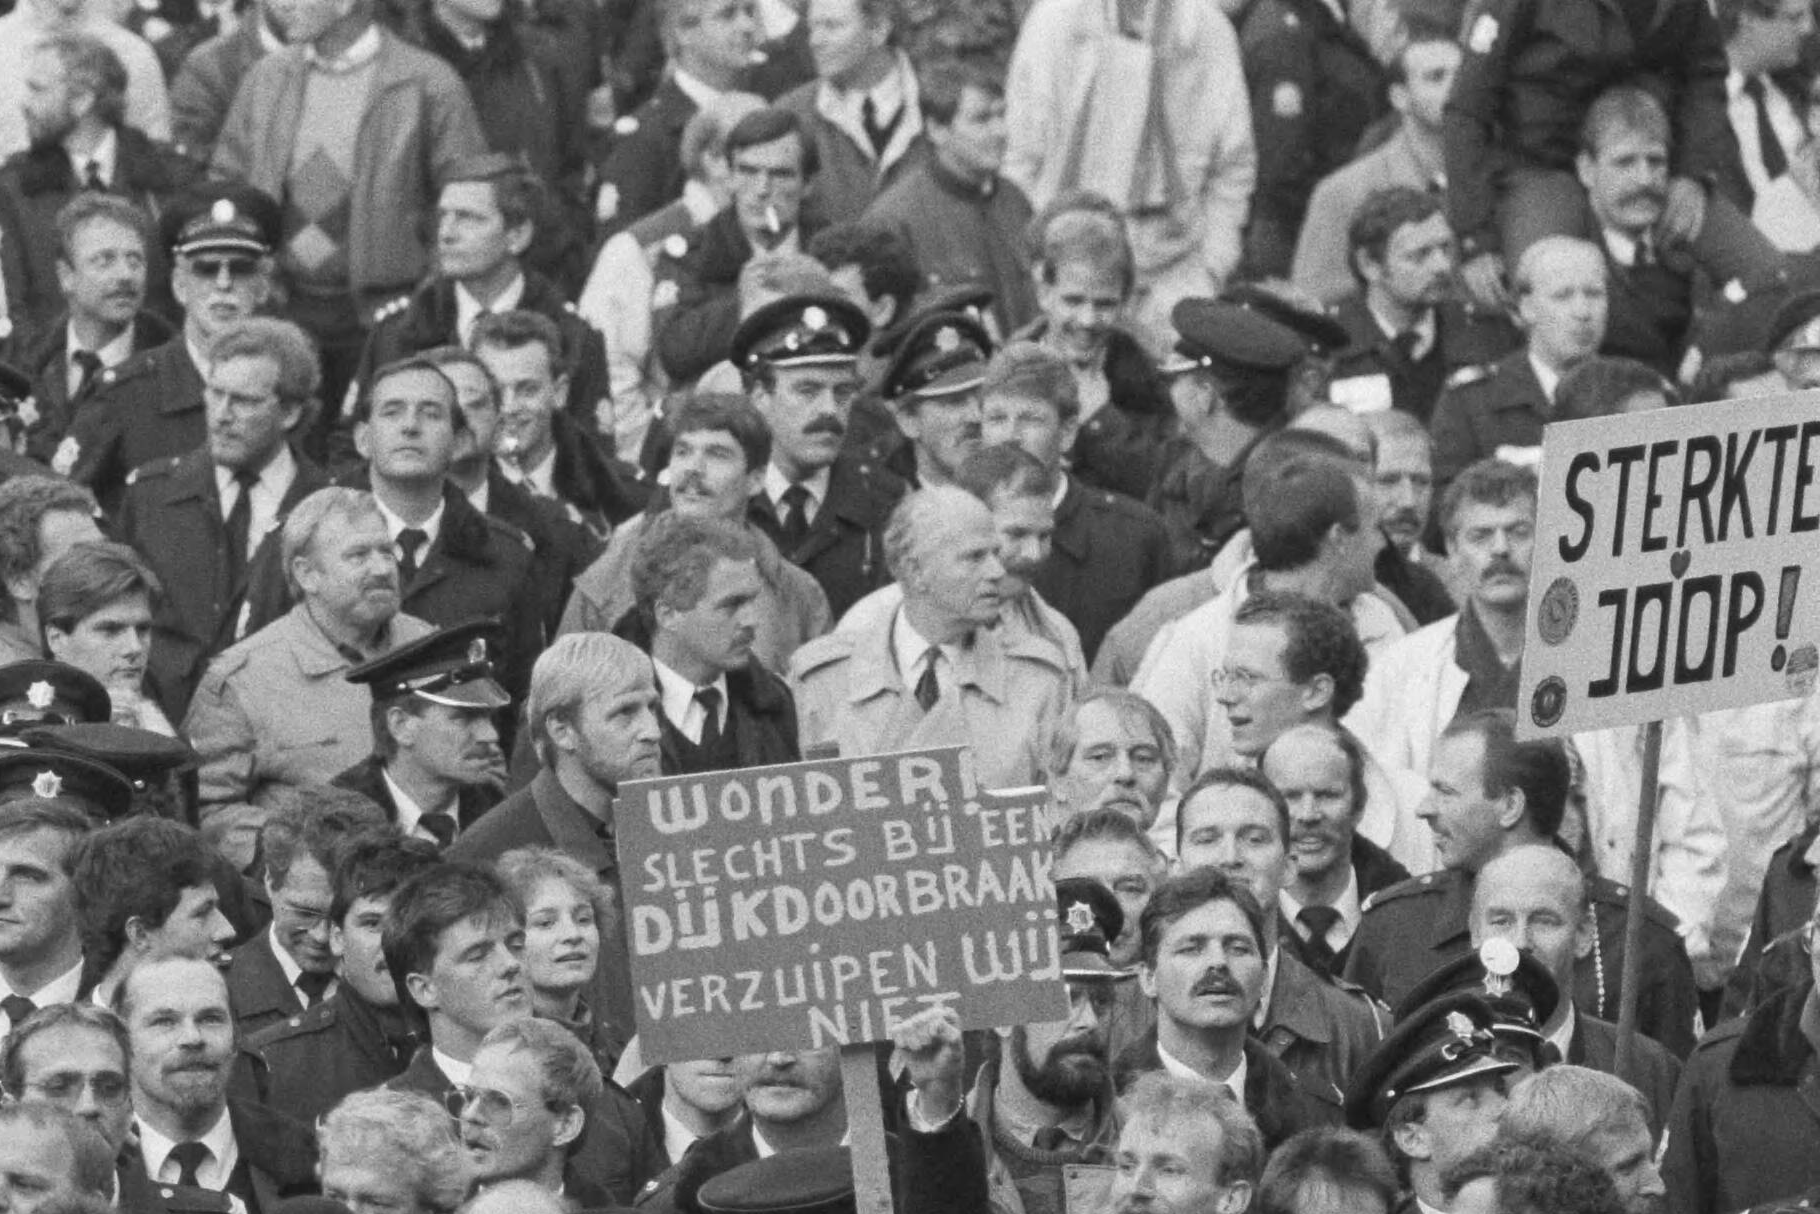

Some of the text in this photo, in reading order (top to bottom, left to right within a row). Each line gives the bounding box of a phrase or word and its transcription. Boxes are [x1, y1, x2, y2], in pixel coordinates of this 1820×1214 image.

[1557, 420, 1820, 563] STERKTE
[1587, 564, 1802, 699] JOOP!
[643, 827, 857, 894] SLECHTS
[980, 802, 1055, 849] EEN
